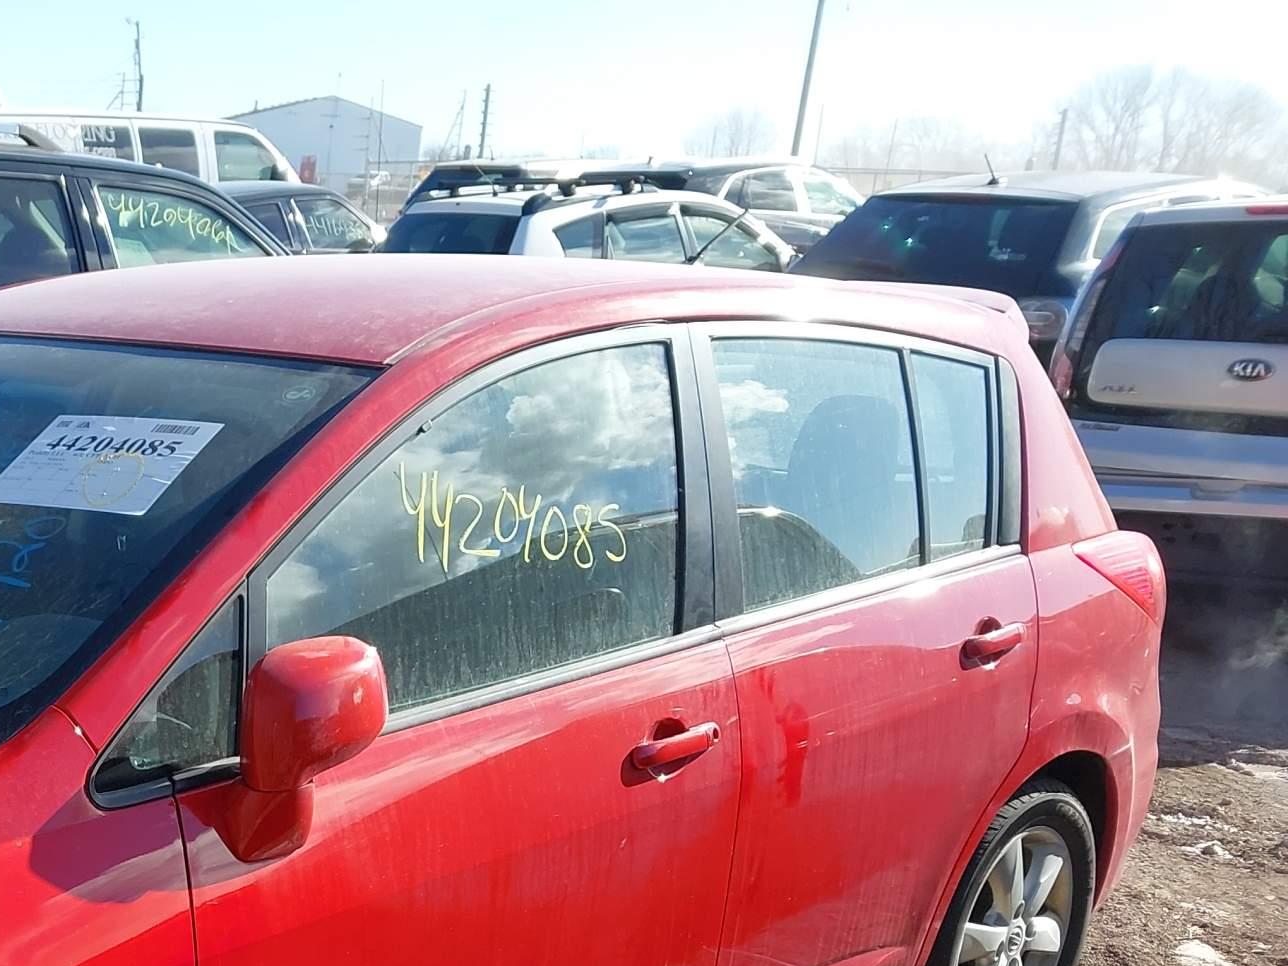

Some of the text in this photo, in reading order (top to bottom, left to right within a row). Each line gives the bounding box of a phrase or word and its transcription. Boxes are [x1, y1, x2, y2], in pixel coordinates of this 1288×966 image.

[1231, 361, 1268, 377] KIA
[46, 434, 184, 457] 44204085
[398, 462, 627, 574] 44204085
